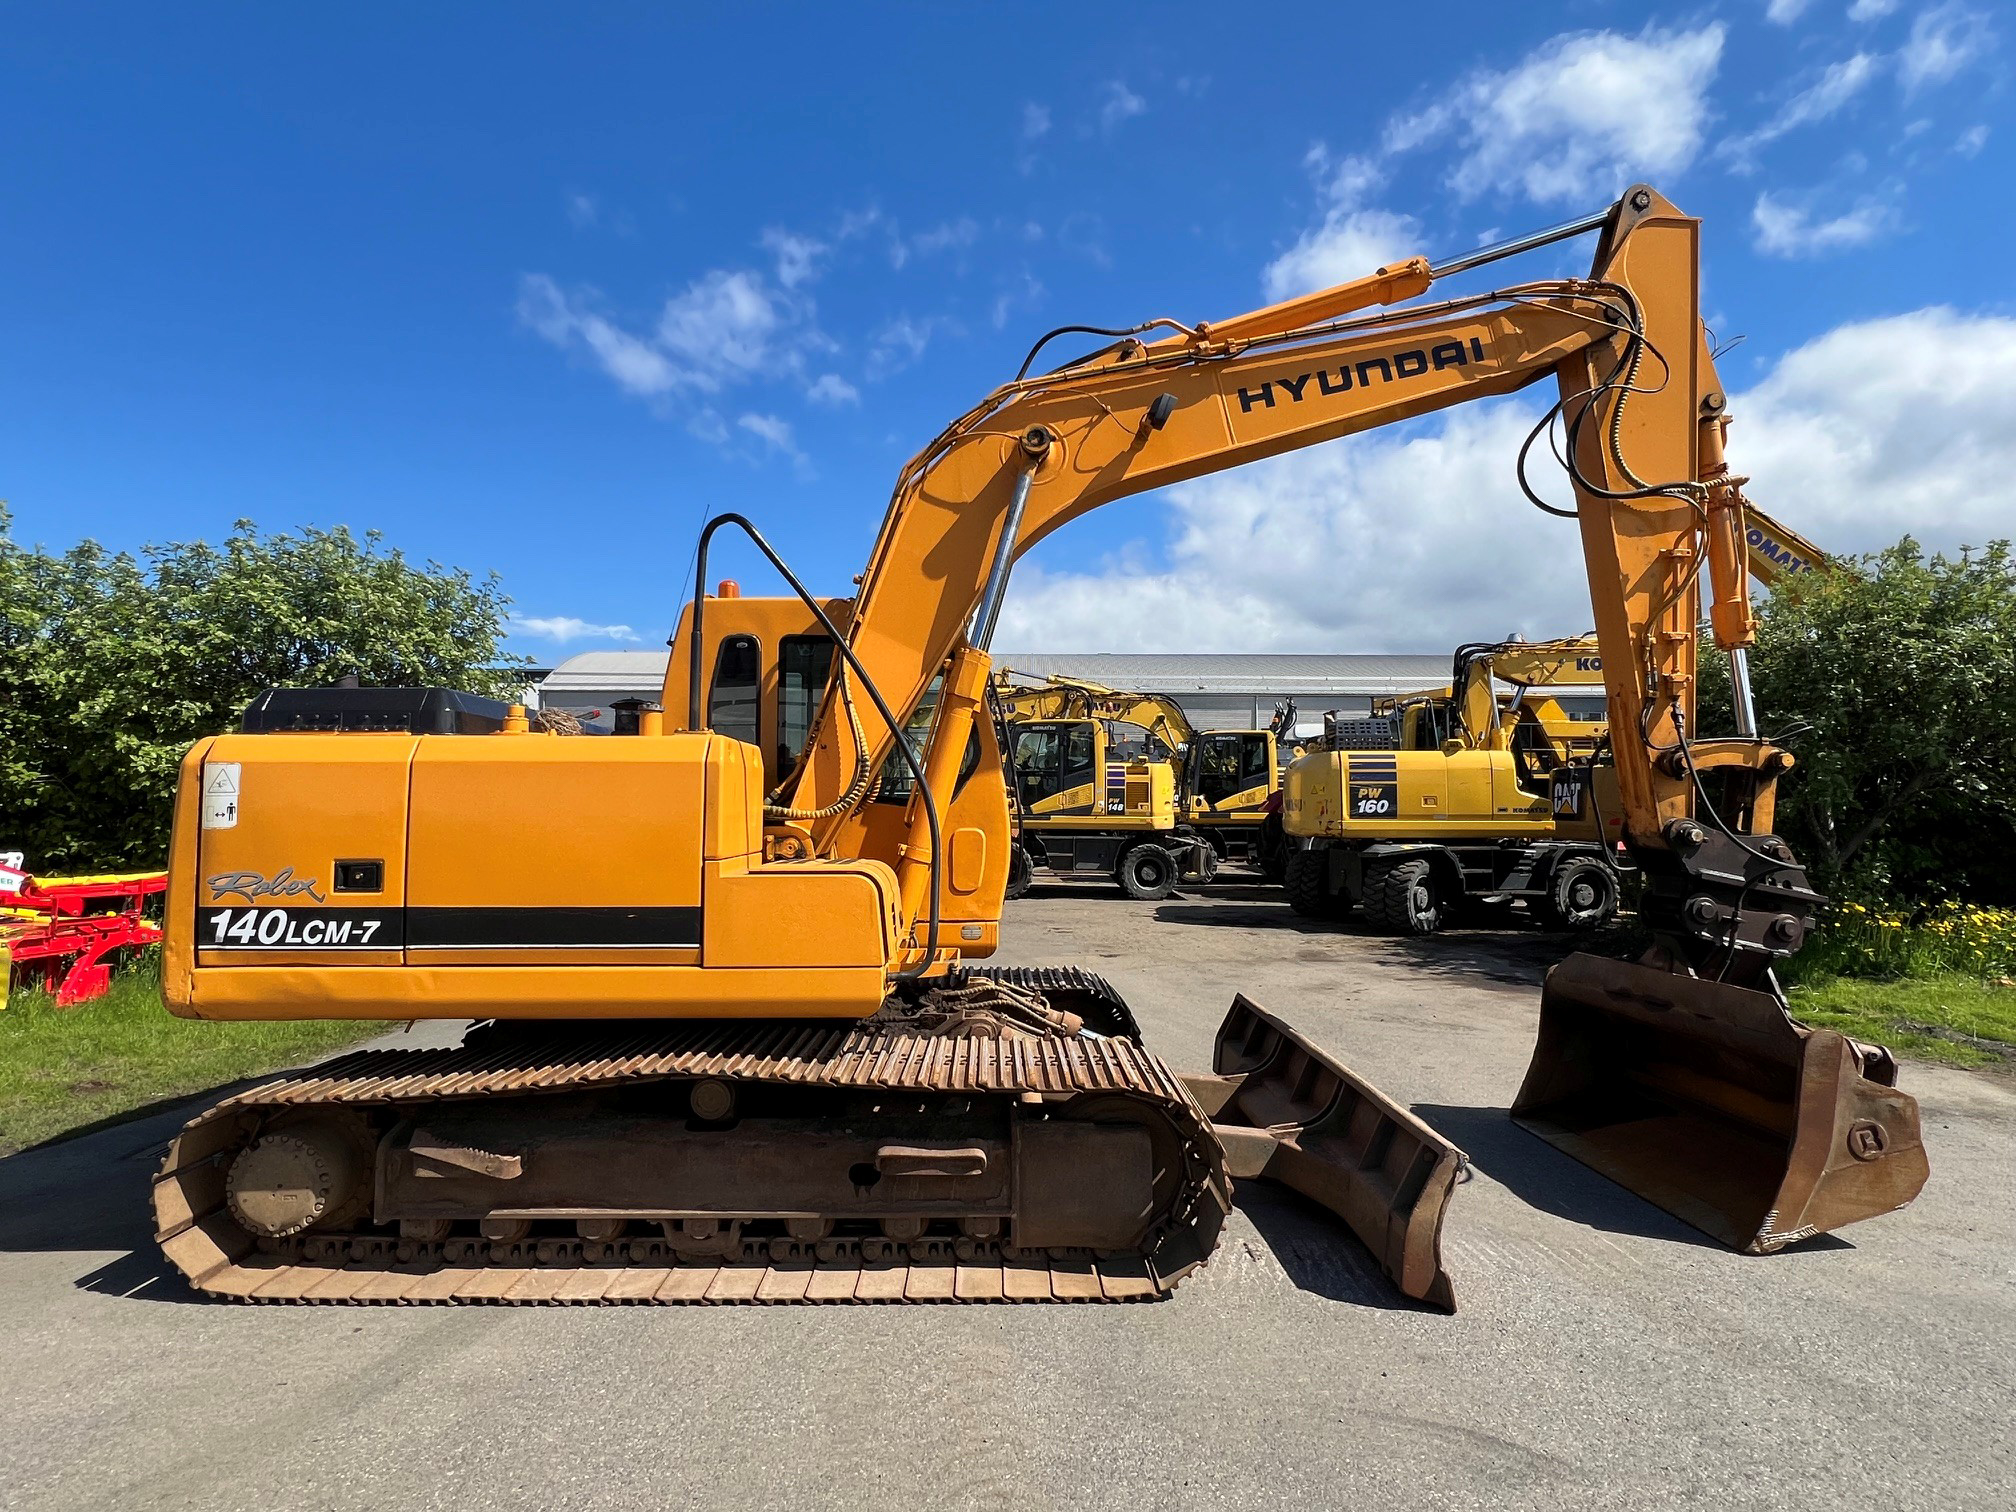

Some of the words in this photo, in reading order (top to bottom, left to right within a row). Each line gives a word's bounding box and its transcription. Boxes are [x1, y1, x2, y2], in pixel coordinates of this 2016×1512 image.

[1238, 337, 1486, 413] HYUNDAI
[1357, 799, 1390, 814] 160
[1358, 788, 1383, 799] PW
[1554, 782, 1581, 814] CAT
[207, 866, 326, 904] Robex
[210, 909, 382, 945] 140LCM-7
